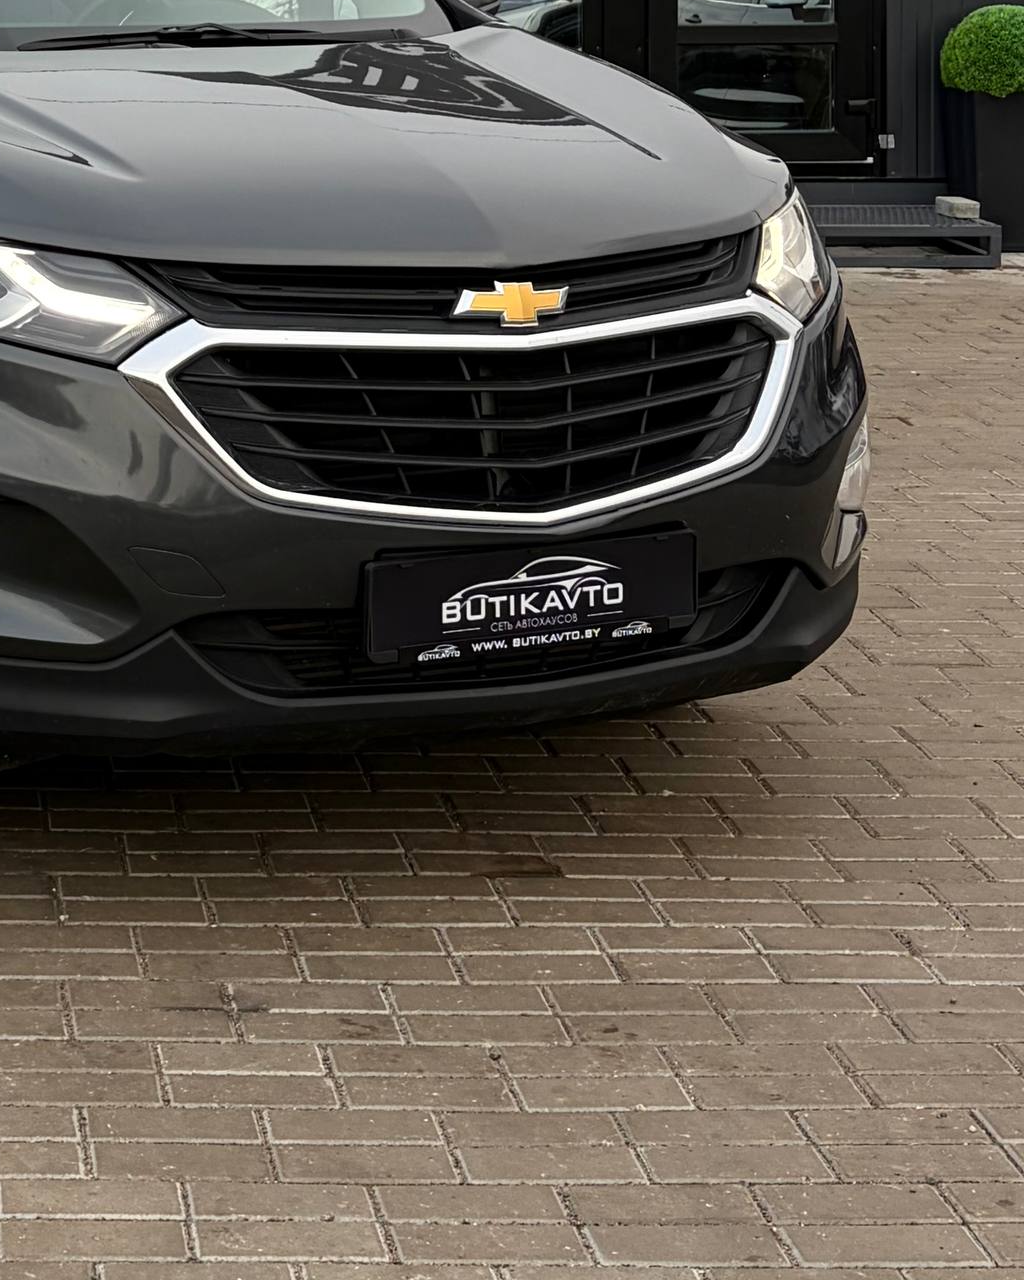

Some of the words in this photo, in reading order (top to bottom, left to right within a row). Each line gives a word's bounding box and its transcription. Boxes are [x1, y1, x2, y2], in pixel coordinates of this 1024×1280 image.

[441, 581, 624, 624] BUTIKAVTO
[489, 621, 514, 632] СЕТЬ
[514, 613, 578, 631] АВТОХАУСОВ
[611, 626, 653, 638] BUTIKAVTO
[512, 627, 601, 648] BUTIKAVTO.BY
[417, 650, 461, 662] BUTIKAVTO
